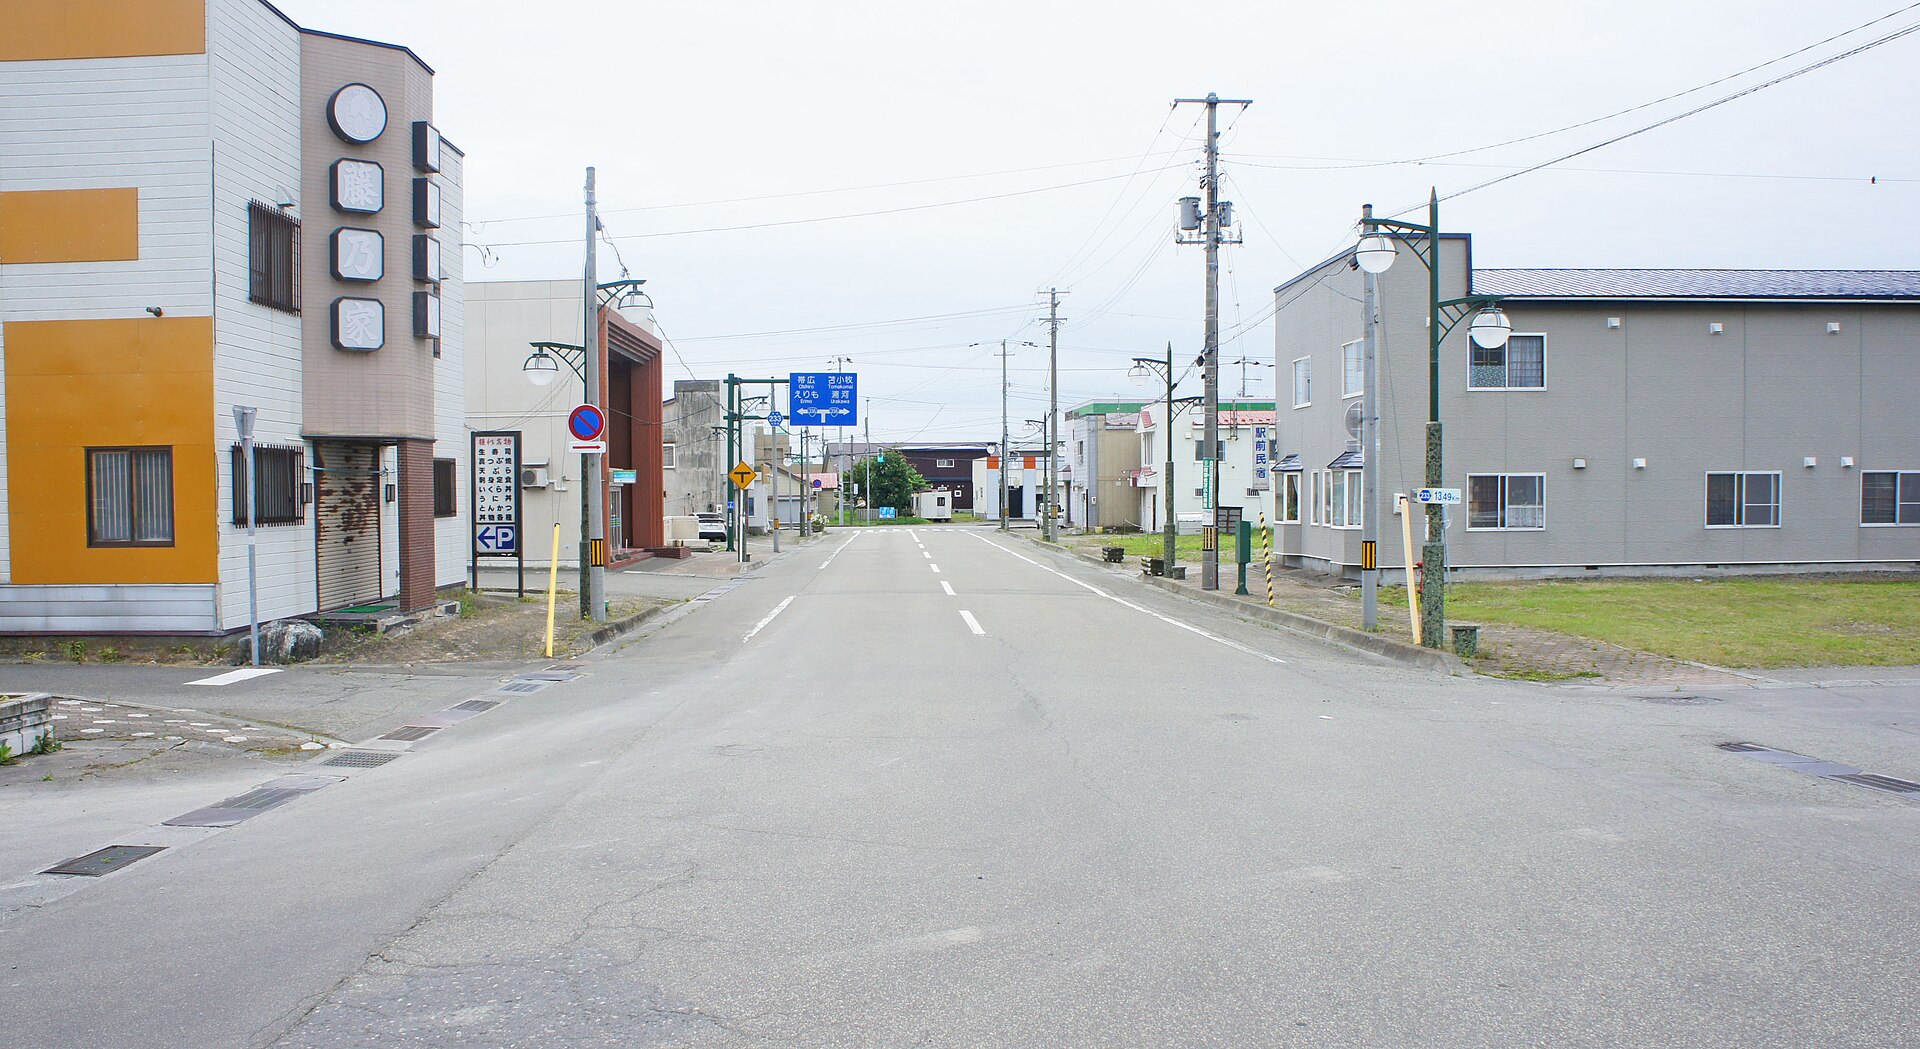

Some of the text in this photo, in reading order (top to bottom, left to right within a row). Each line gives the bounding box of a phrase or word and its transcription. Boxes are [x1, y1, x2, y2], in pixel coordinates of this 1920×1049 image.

[343, 162, 379, 346] 藤乃家
[797, 376, 815, 384] 帯広
[828, 376, 853, 384] 苫小牧
[794, 390, 819, 399] えりも
[831, 390, 850, 399] 浦河
[1255, 426, 1267, 479] 駅前民宿
[478, 485, 512, 493] いくら丼
[479, 494, 512, 503] うに丼
[497, 528, 514, 548] P
